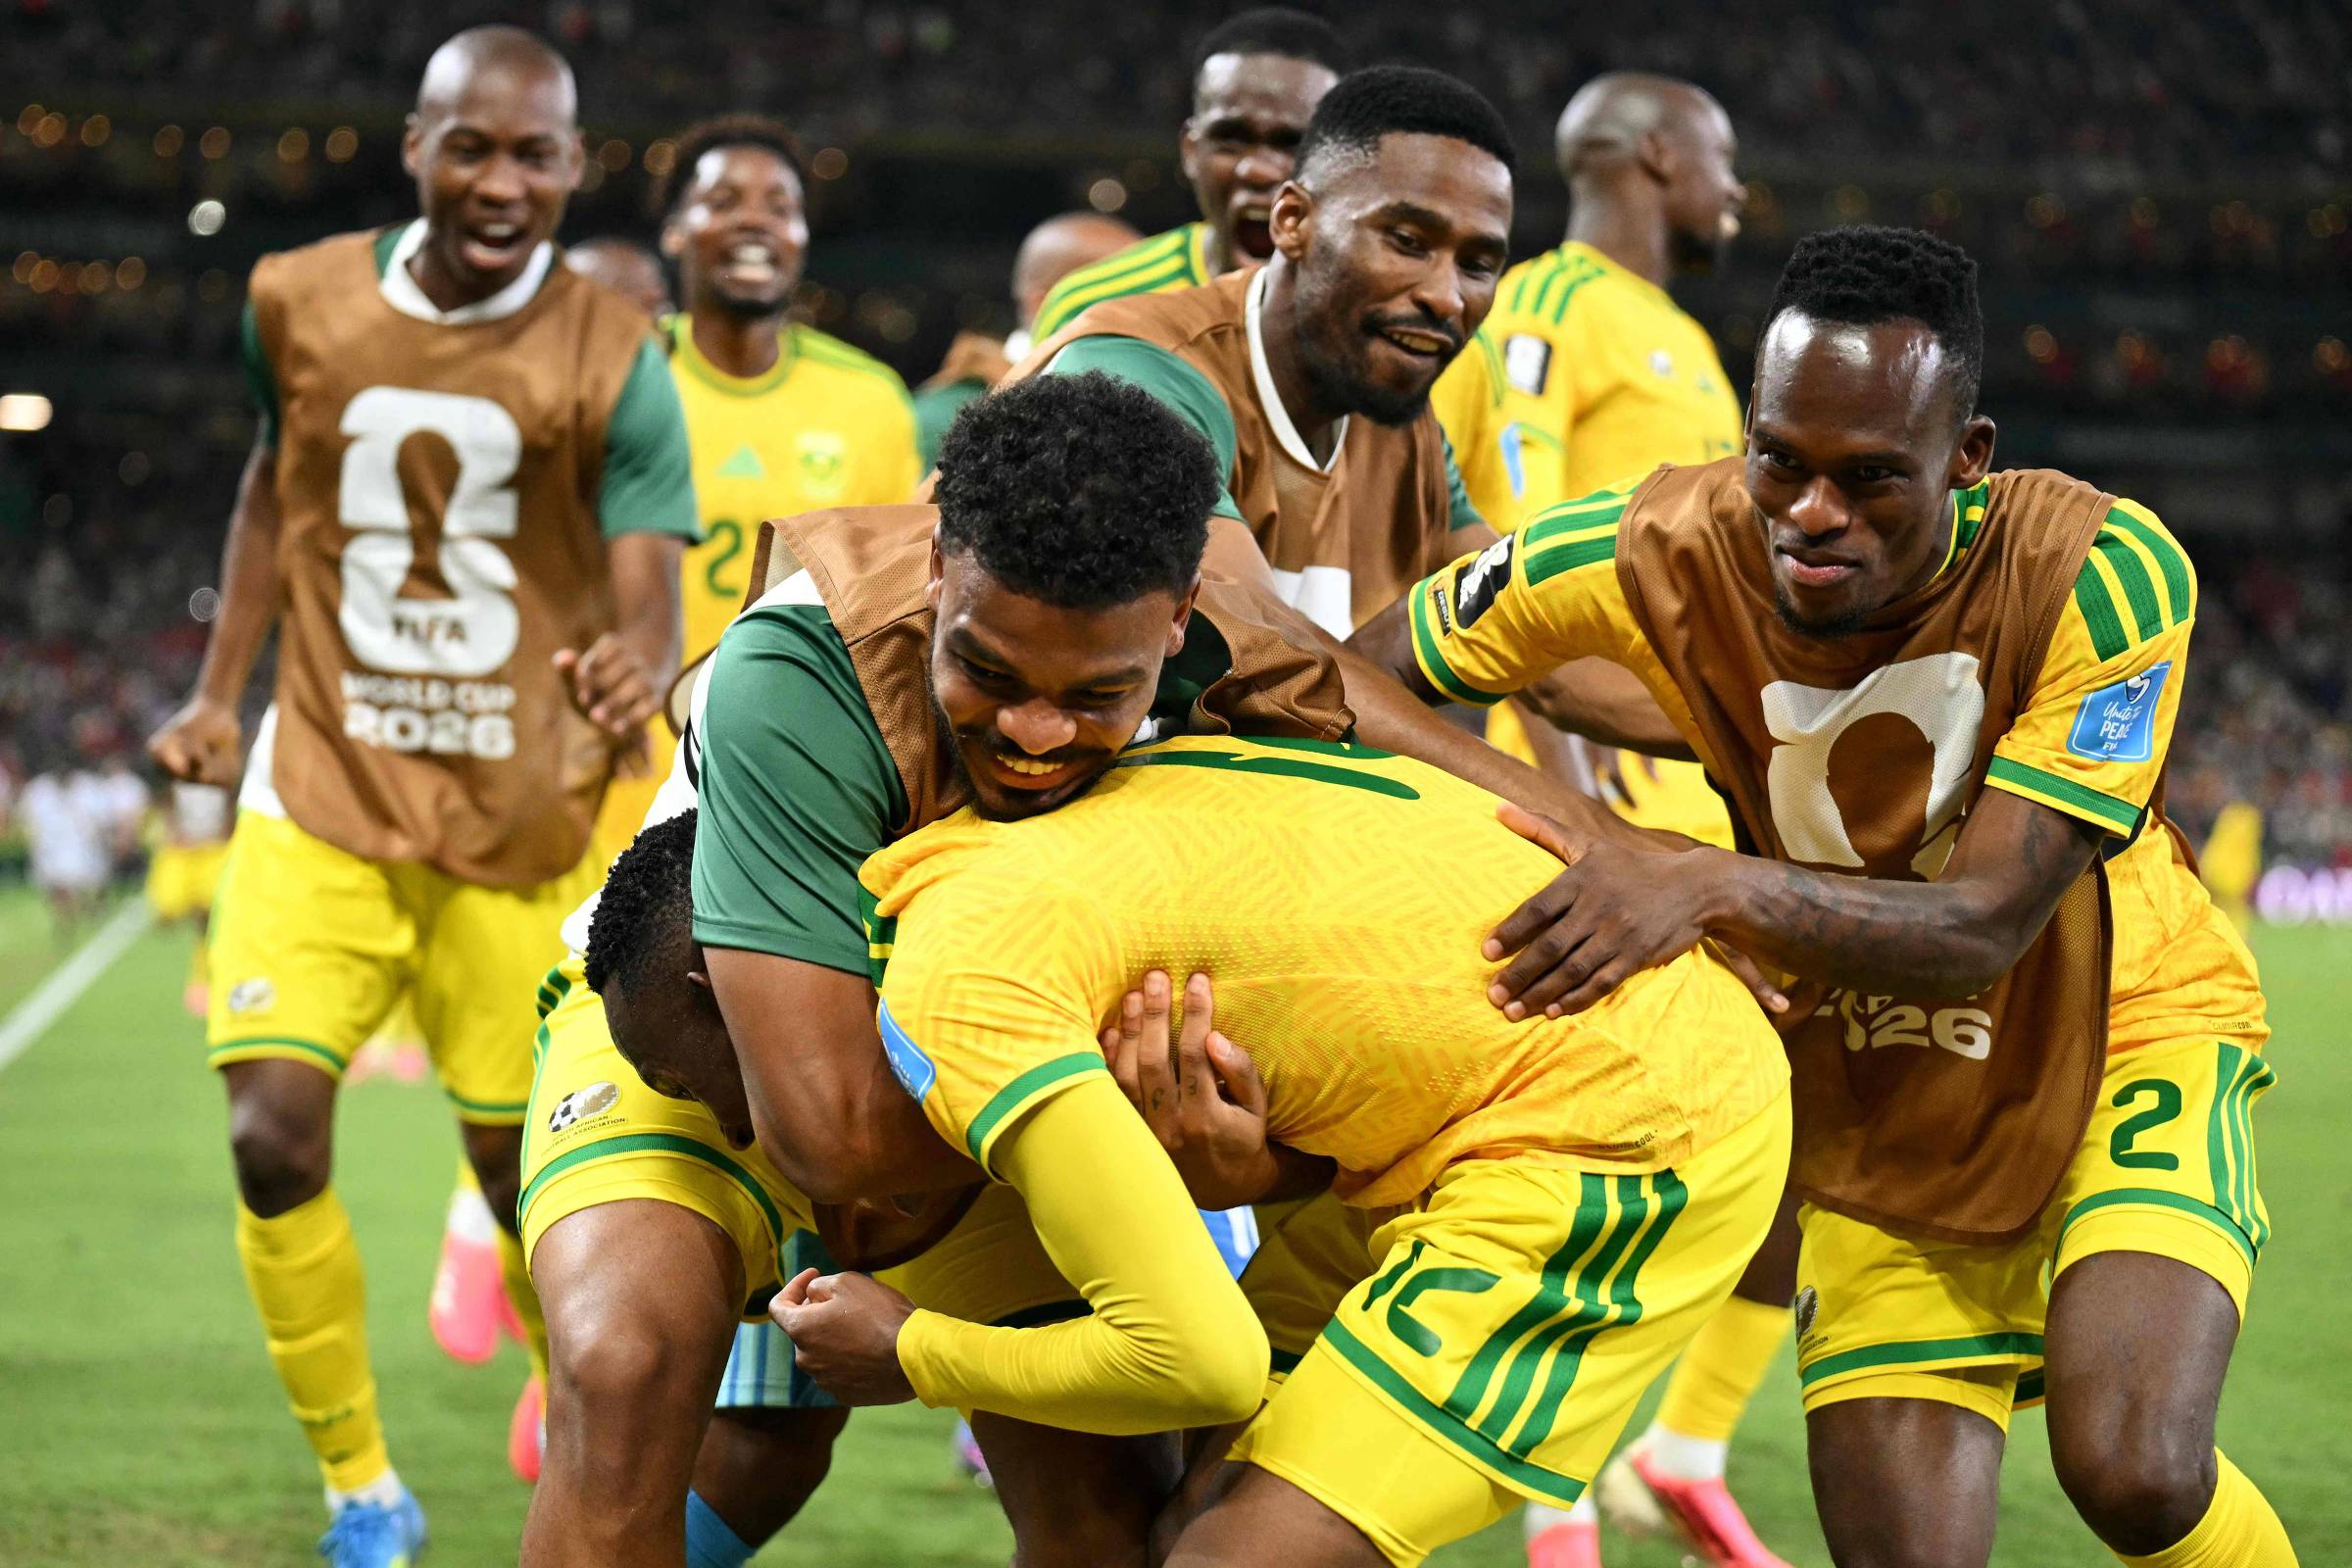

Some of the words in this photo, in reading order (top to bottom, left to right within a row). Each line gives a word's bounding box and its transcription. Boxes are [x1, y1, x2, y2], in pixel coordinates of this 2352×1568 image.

[339, 670, 452, 710] WORLD
[454, 681, 517, 712] CUP
[2103, 701, 2132, 720] Unite
[342, 701, 517, 761] 2026
[573, 1117, 625, 1136] ASSOCIATION
[575, 1114, 609, 1129] AFRICAN
[2110, 1078, 2182, 1172] 2
